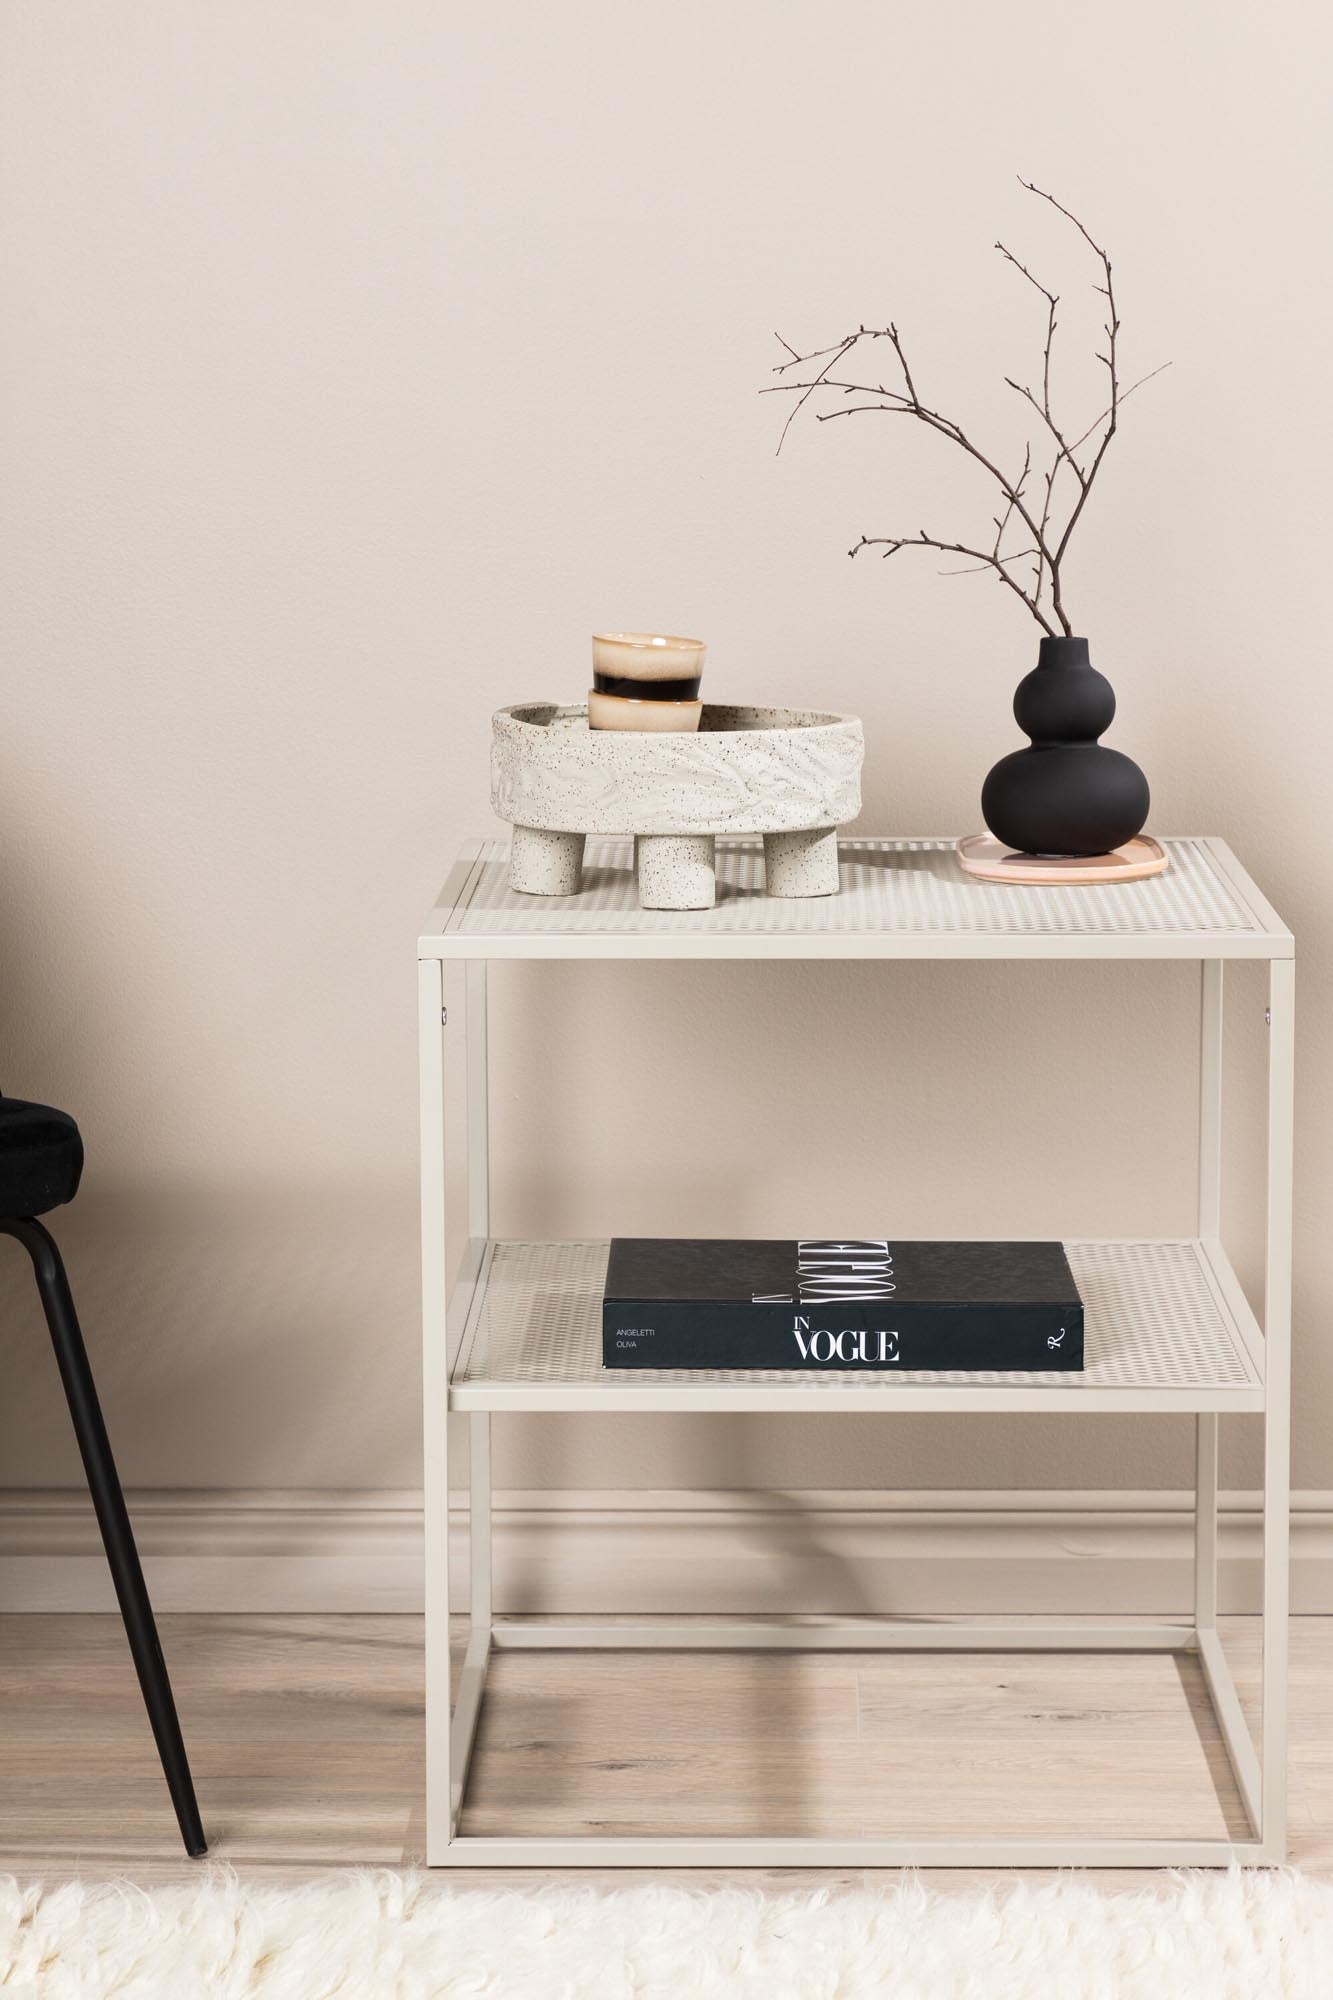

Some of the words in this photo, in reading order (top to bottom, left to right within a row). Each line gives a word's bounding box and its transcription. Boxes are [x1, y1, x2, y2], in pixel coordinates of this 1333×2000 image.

[795, 1241, 897, 1305] VOGUE
[793, 1316, 810, 1330] IN
[616, 1329, 655, 1337] ANGELETTI
[616, 1340, 637, 1348] OLIVA
[792, 1330, 900, 1362] VOGUE
